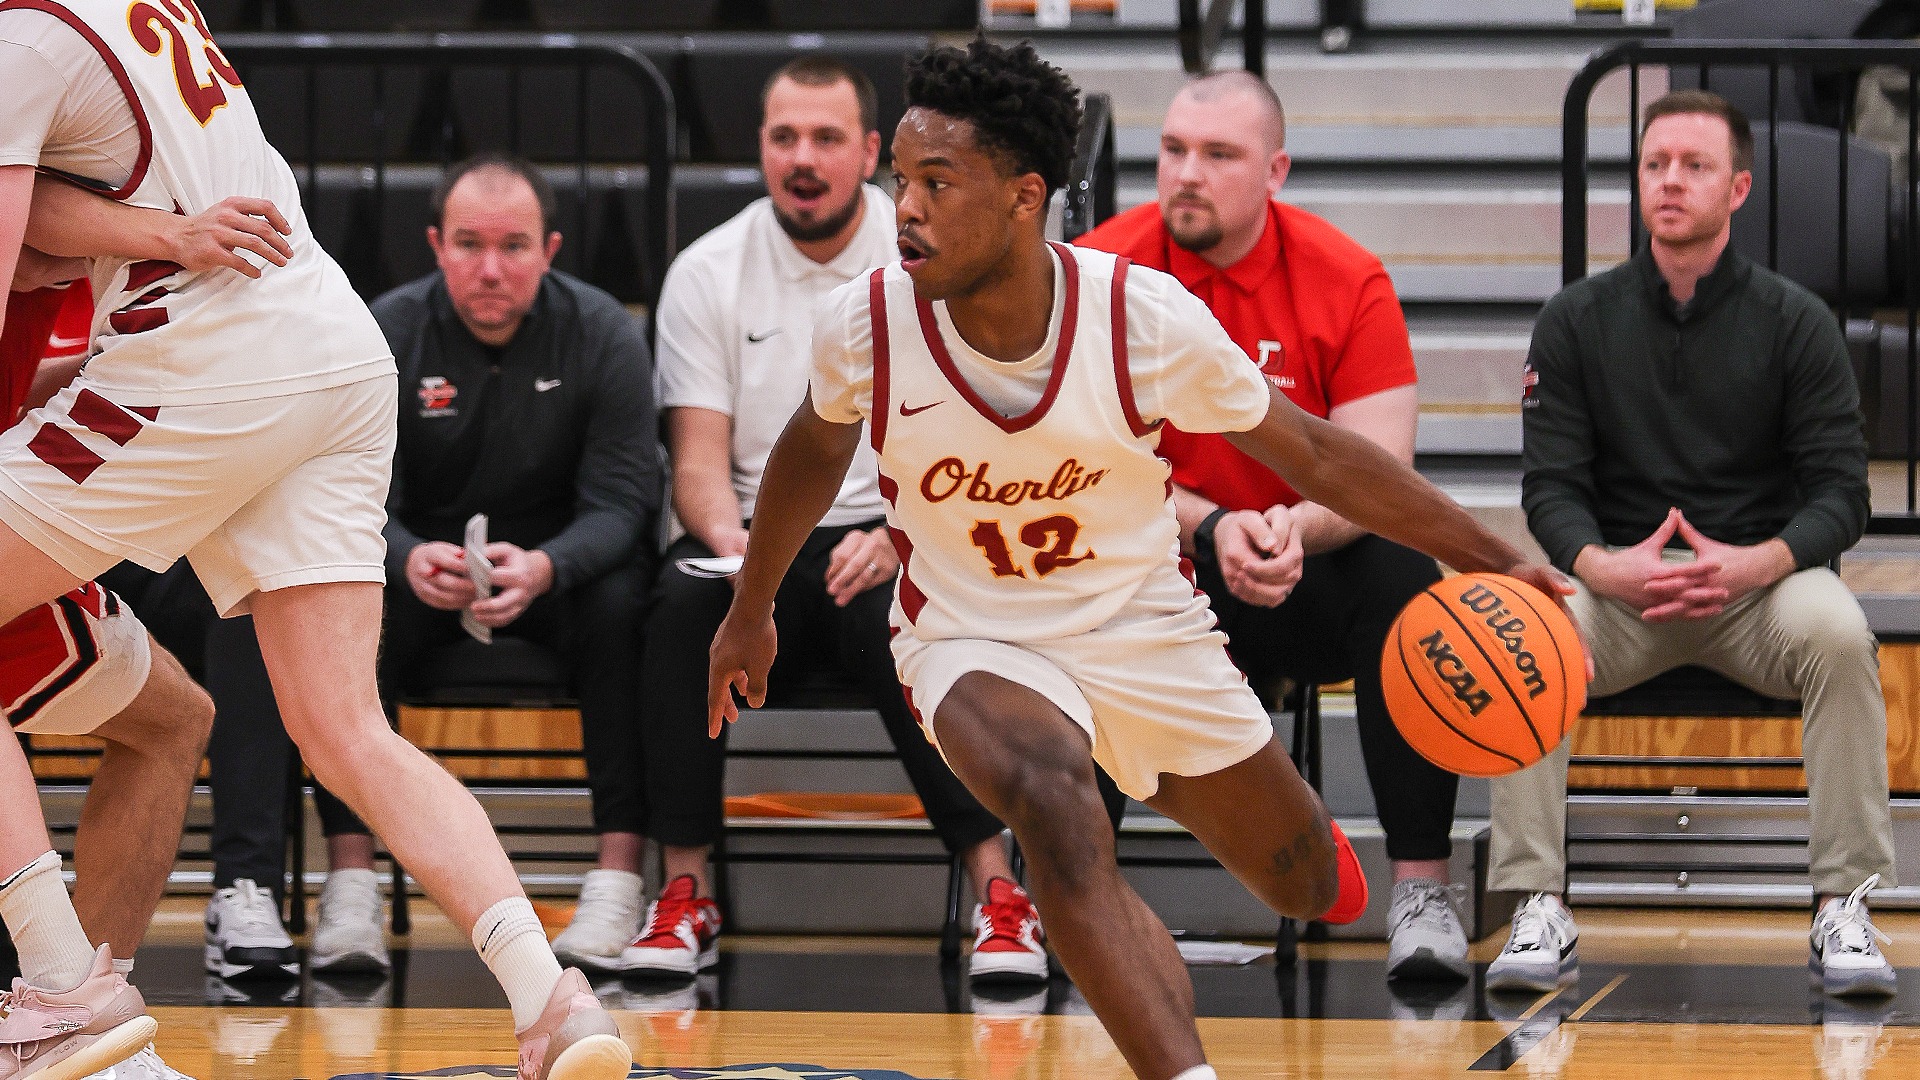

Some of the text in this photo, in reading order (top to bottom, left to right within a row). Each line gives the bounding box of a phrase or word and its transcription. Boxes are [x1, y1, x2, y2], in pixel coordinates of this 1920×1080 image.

[919, 455, 1111, 507] Oberlin
[968, 513, 1097, 580] 12
[1418, 629, 1495, 718] NCAA
[1459, 582, 1548, 700] Wilson
